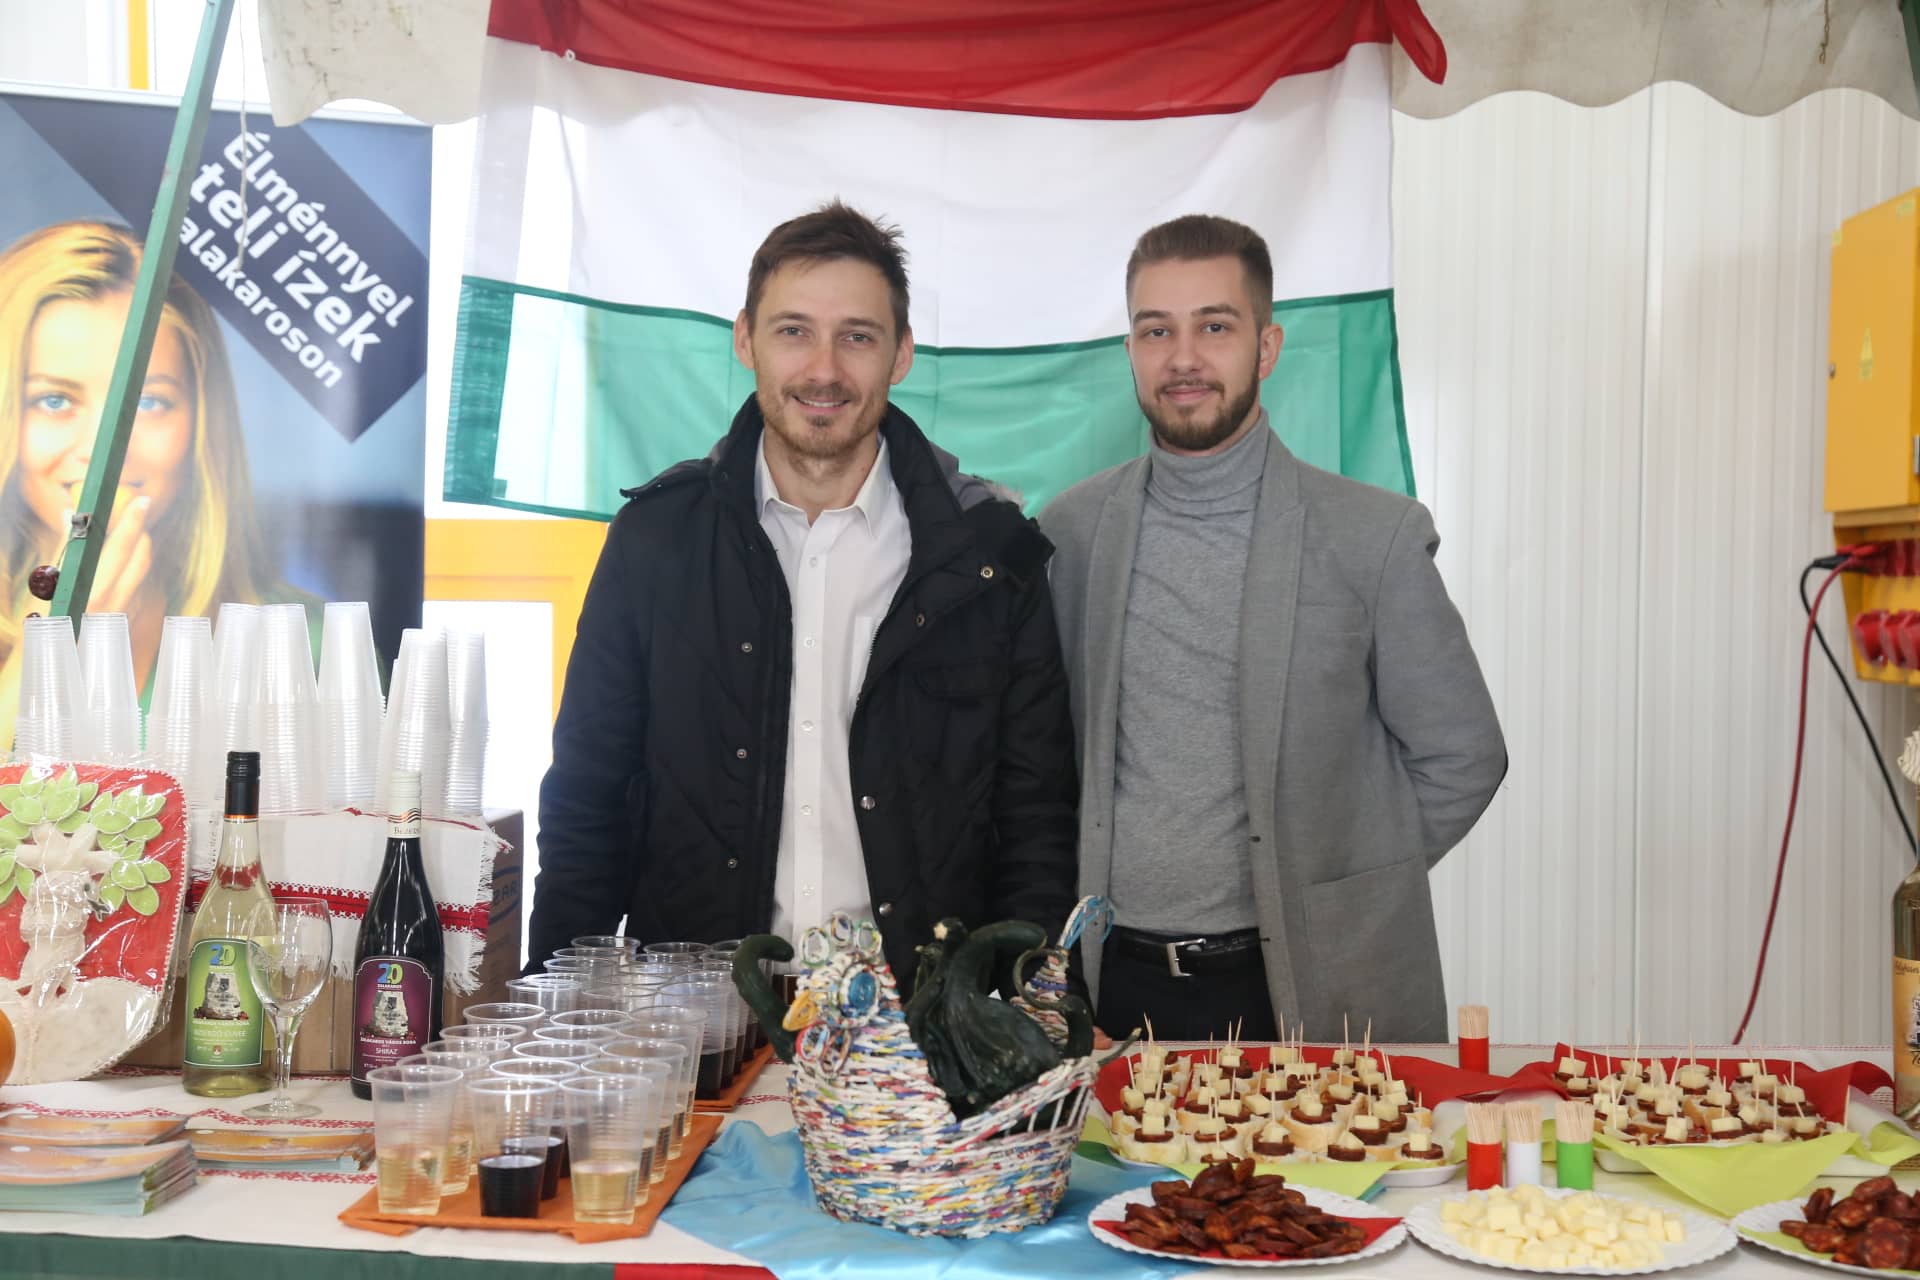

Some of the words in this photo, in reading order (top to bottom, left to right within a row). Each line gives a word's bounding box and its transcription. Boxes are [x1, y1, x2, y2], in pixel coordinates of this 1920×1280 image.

[180, 216, 343, 388] alakaroson
[190, 162, 289, 259] teli
[272, 249, 381, 363] ízek
[223, 132, 414, 328] Élménnyel
[209, 944, 236, 966] 20
[377, 963, 403, 985] 20
